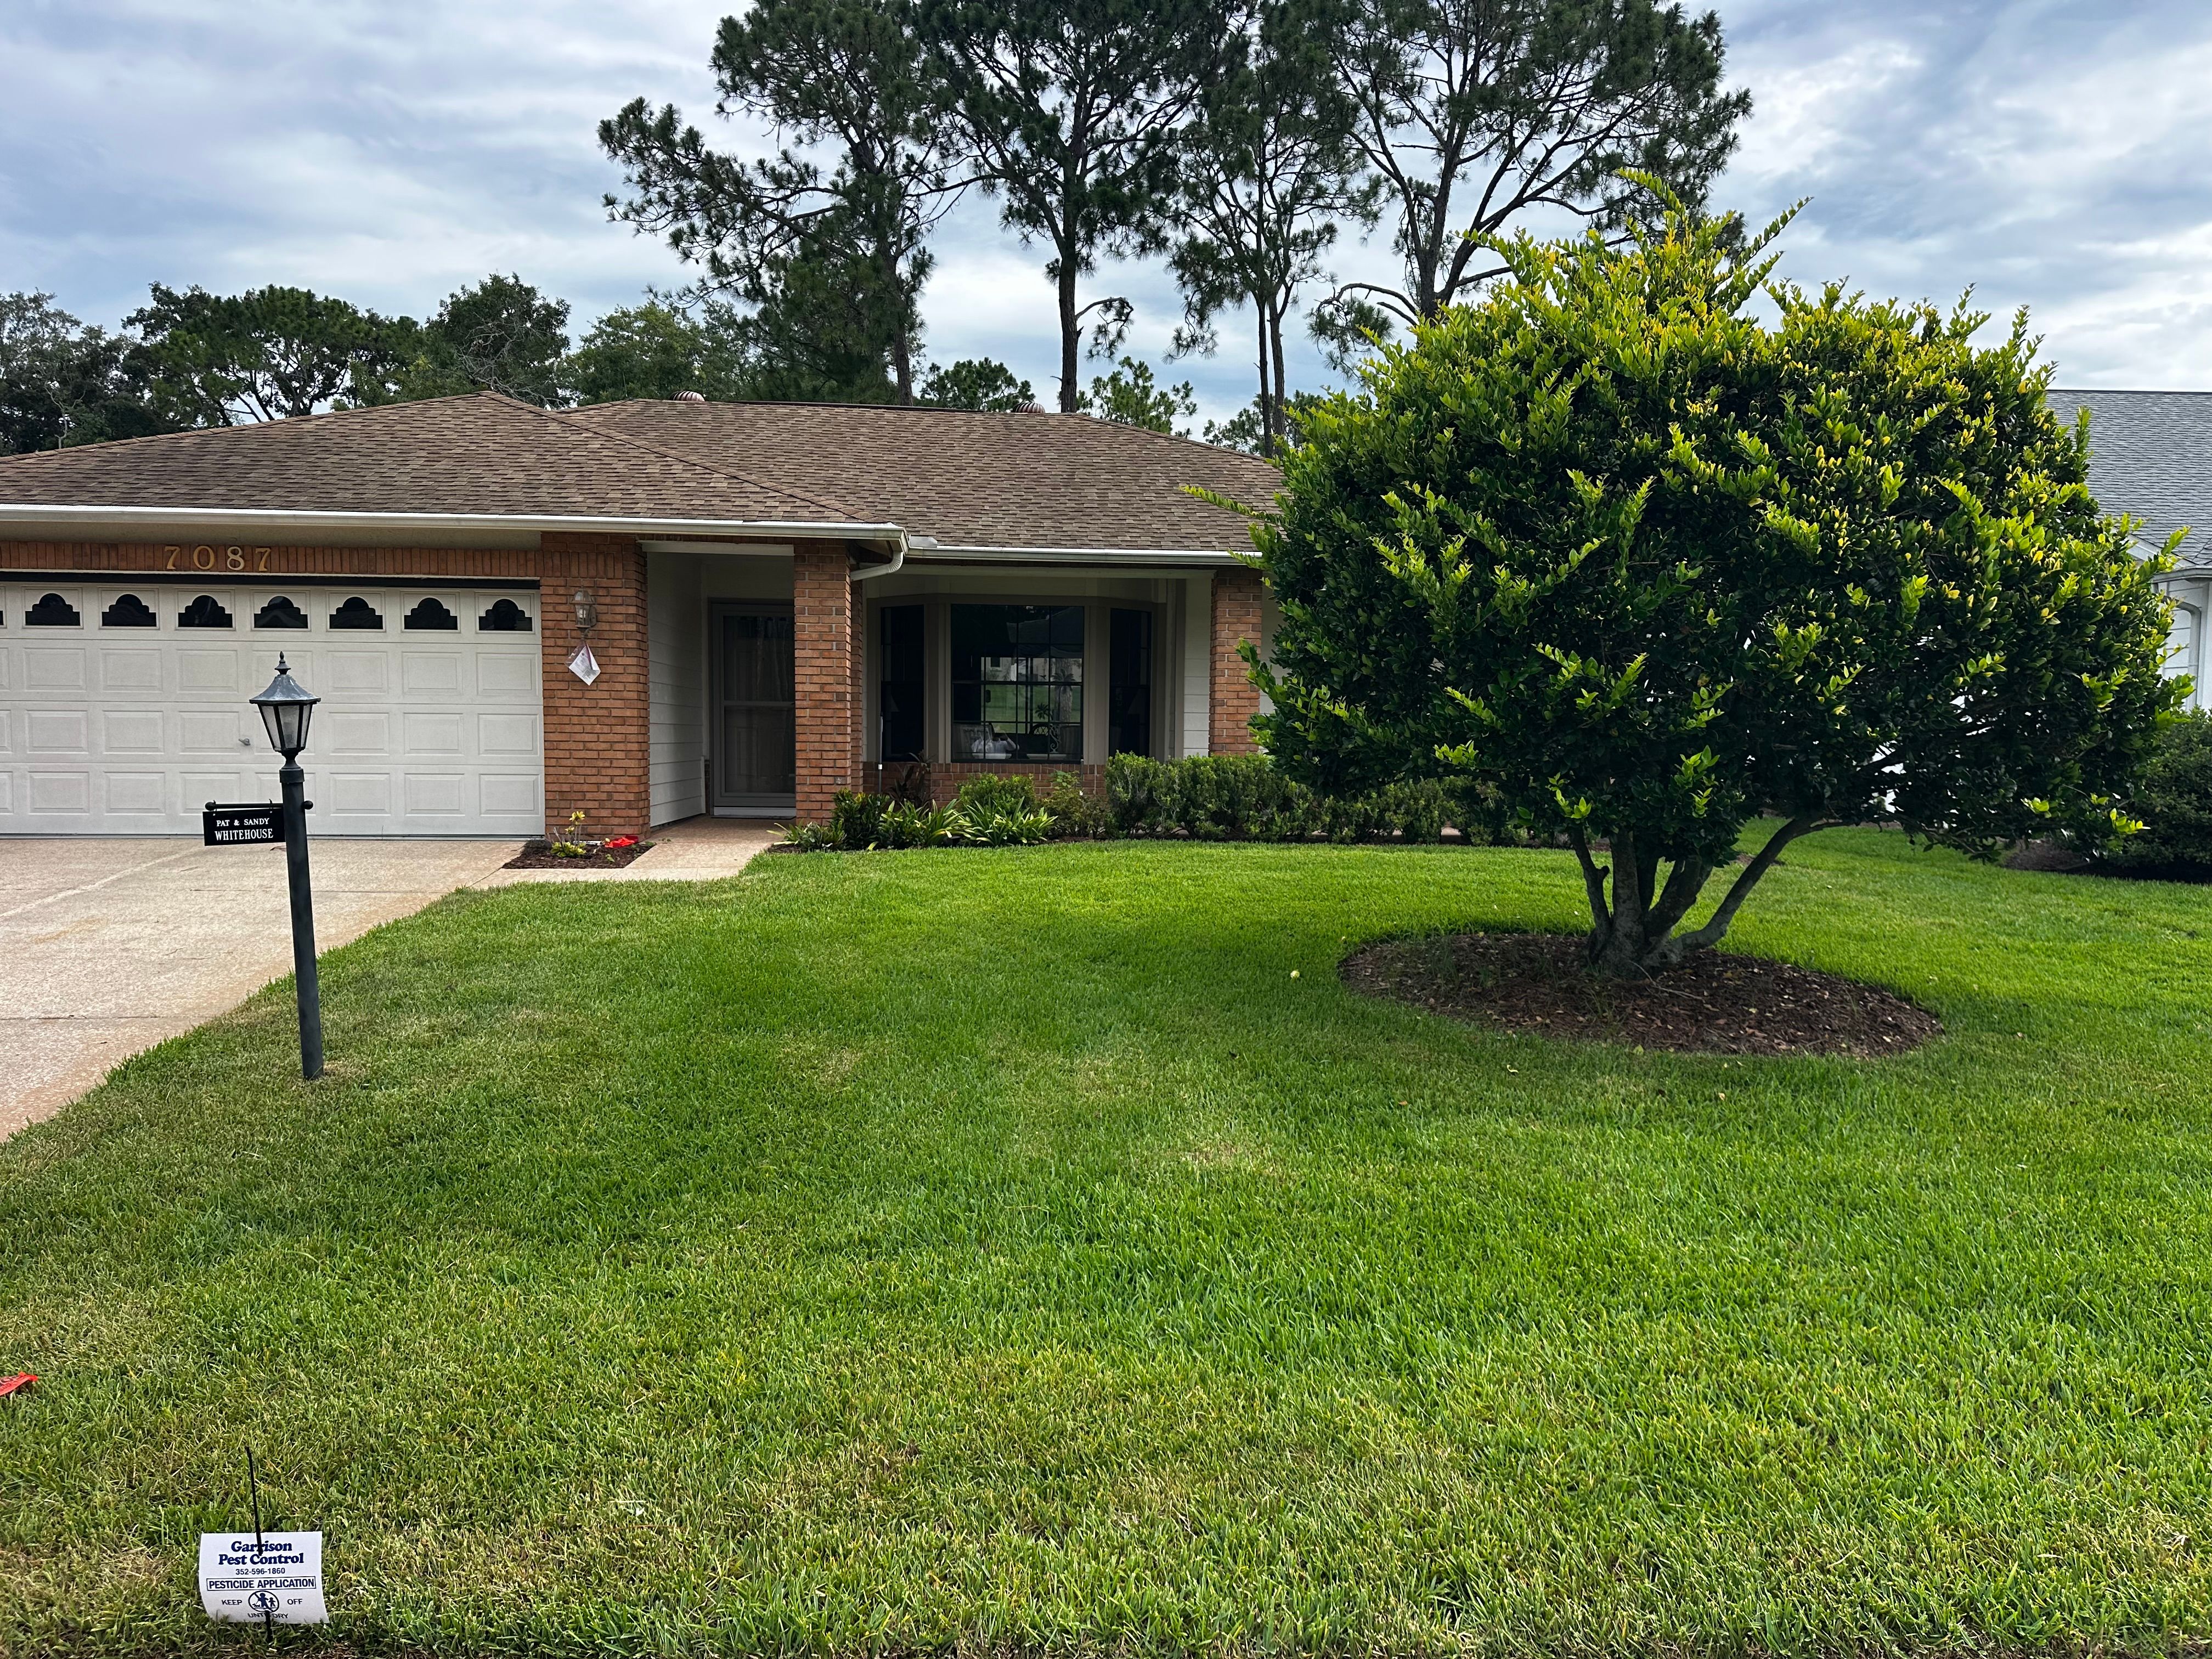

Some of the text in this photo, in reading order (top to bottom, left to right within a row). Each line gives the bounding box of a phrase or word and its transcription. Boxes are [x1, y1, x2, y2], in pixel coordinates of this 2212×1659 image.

[165, 545, 271, 571] 7087
[244, 817, 270, 826] SANDY
[215, 828, 274, 840] WHITEHOUSE
[218, 1553, 304, 1565] Pest Control
[209, 1578, 314, 1589] PESTICIDE APPLICATION
